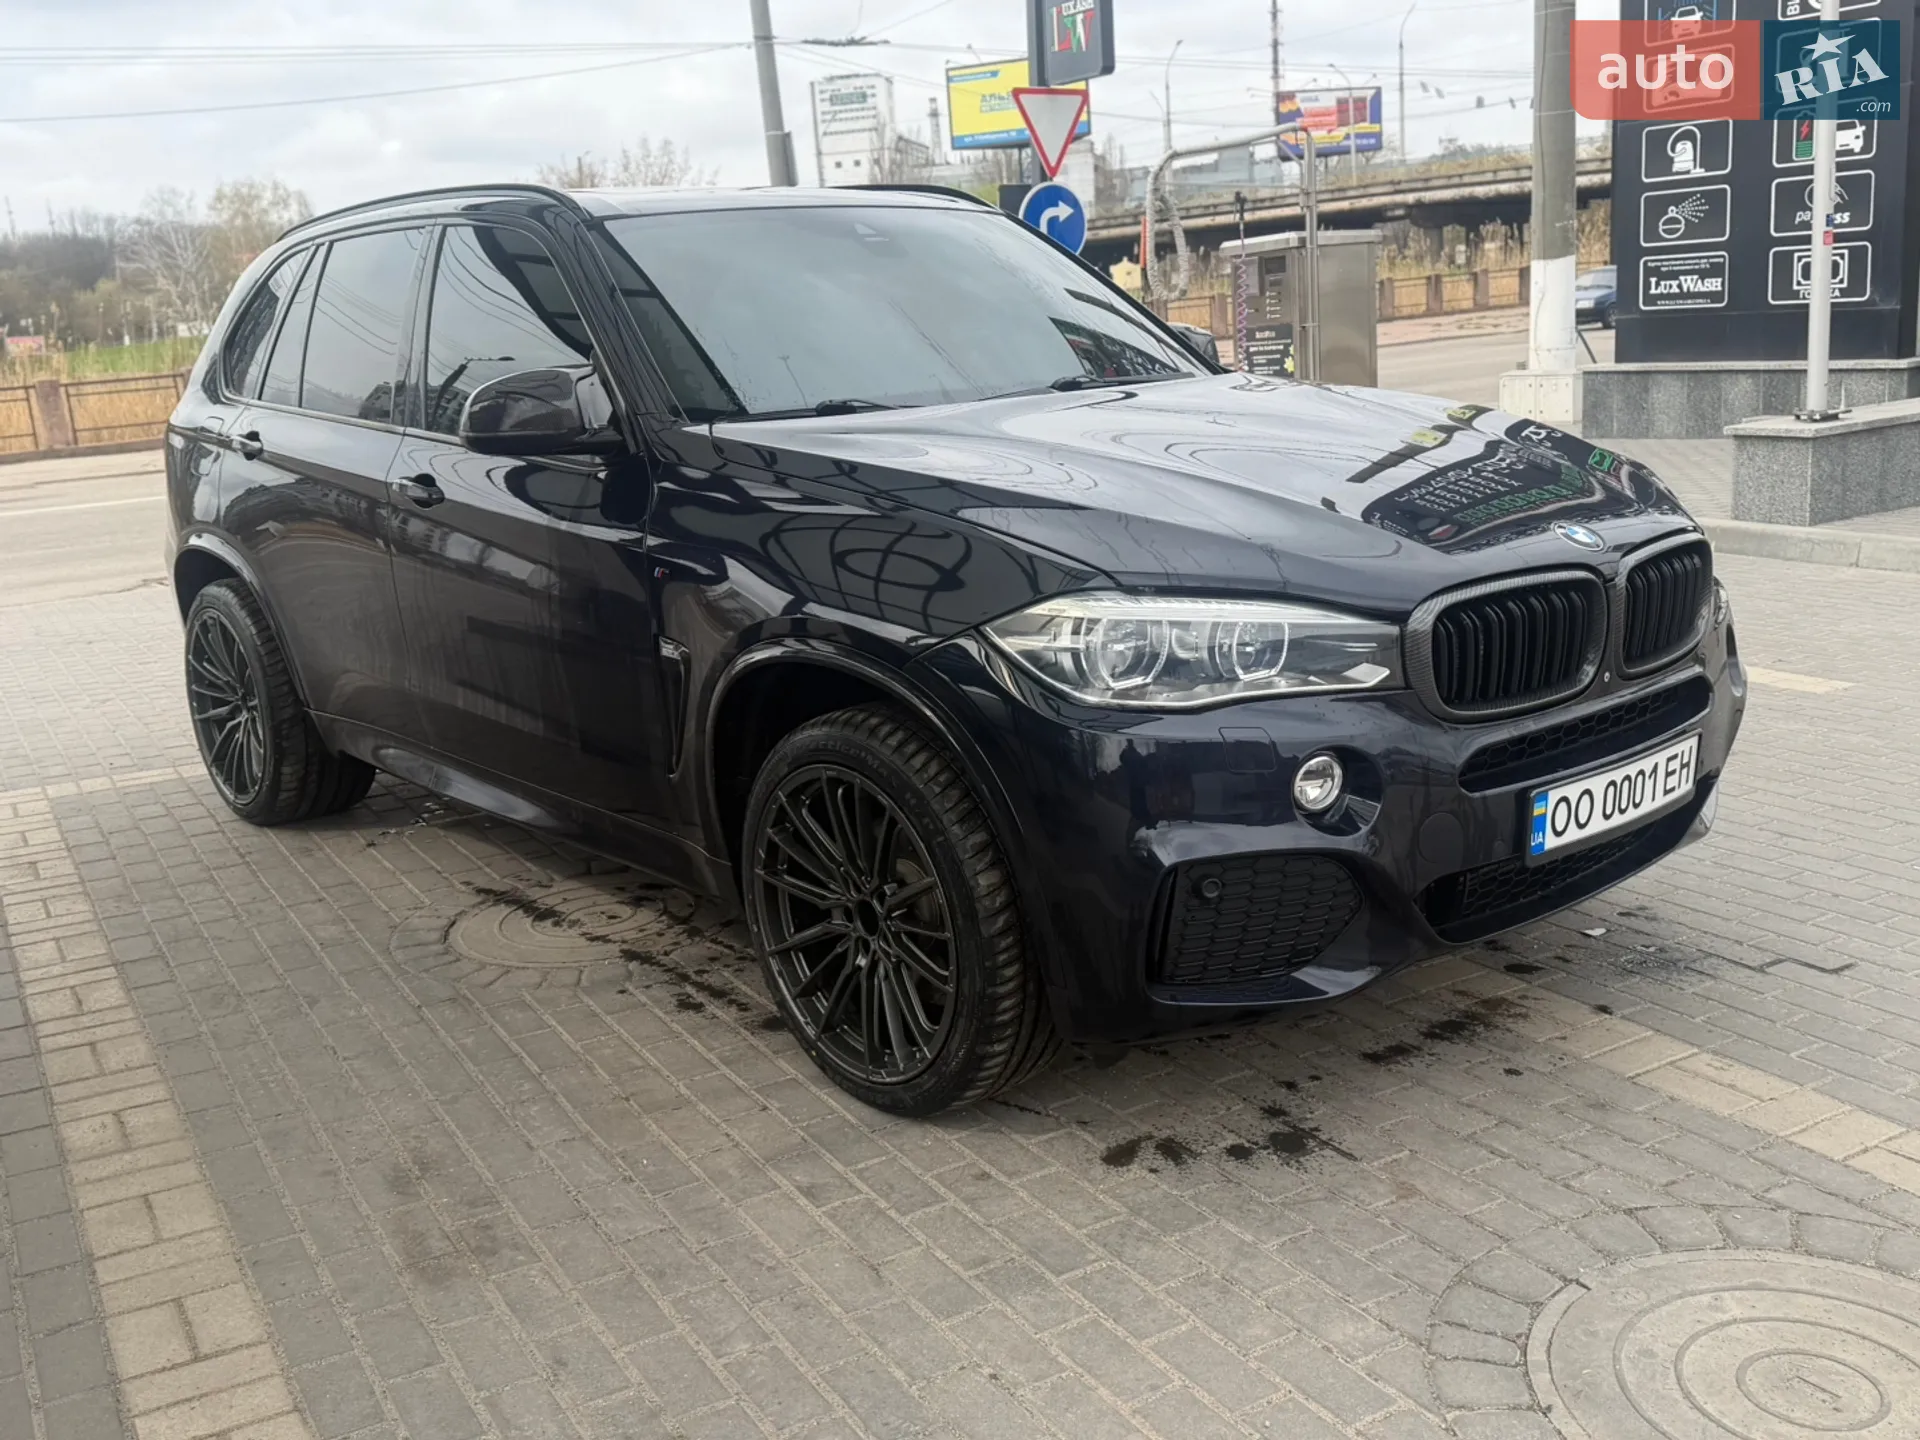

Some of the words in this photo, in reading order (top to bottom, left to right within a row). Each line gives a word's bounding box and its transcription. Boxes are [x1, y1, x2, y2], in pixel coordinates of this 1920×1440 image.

[1551, 788, 1595, 838] OO
[1602, 761, 1659, 821] 0001
[1662, 745, 1693, 797] EH
[1531, 831, 1544, 846] UA
